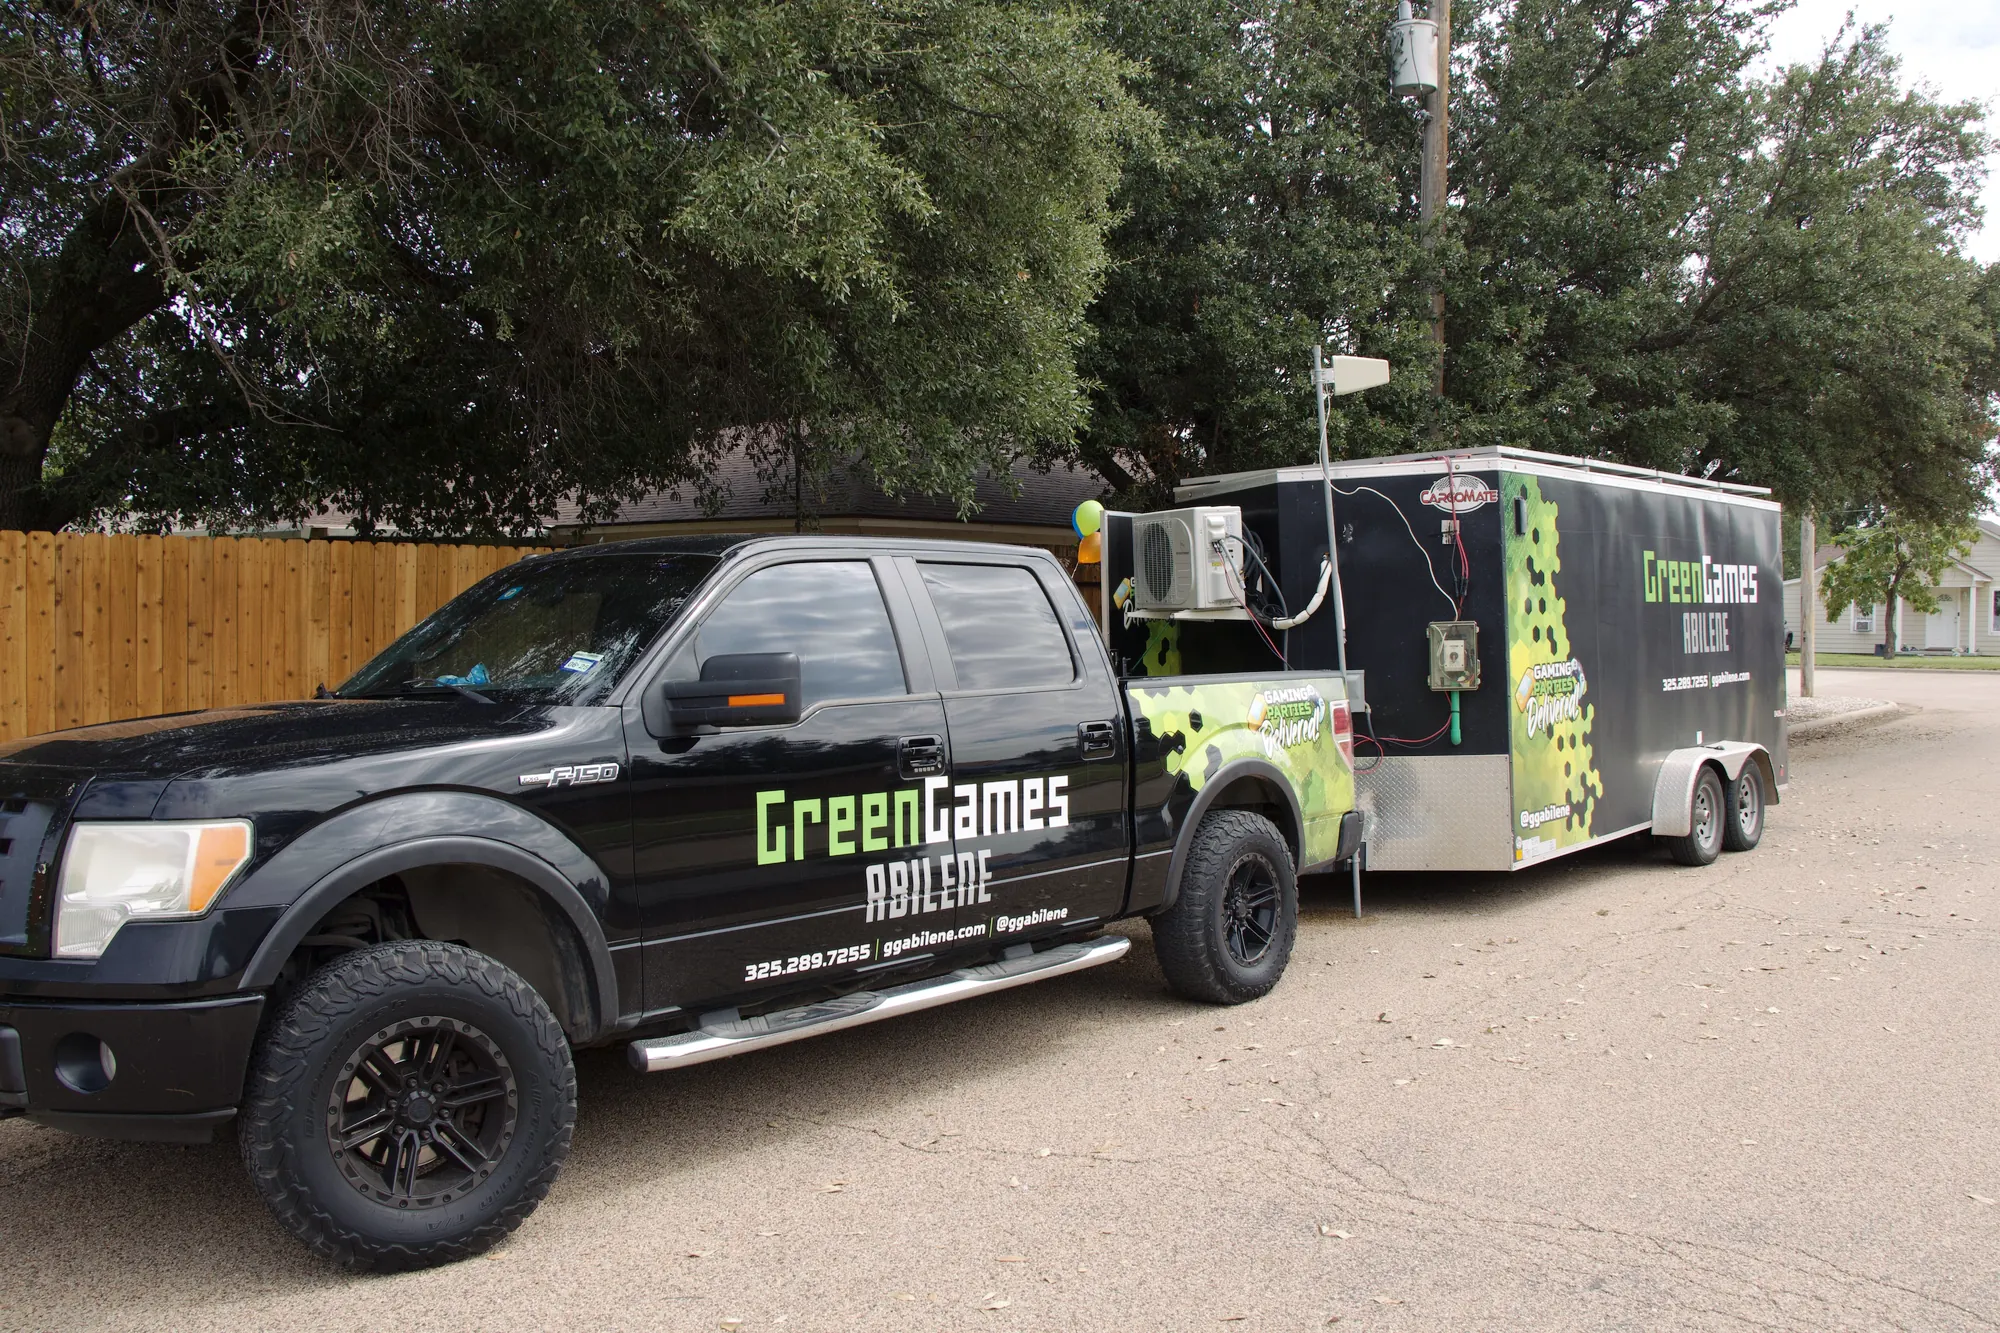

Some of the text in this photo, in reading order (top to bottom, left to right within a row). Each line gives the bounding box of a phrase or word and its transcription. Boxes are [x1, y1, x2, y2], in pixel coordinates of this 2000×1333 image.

[1682, 612, 1730, 654] ABILENE
[1534, 661, 1573, 680] GAMING
[1662, 670, 1750, 692] 325.289.7255 ggabilene.com
[1264, 687, 1308, 705] GAMING
[1533, 677, 1575, 697] PARTIES
[1266, 701, 1312, 720] PARTIES
[547, 763, 619, 788] F-150
[1520, 804, 1570, 829] @ggabilene
[865, 849, 992, 923] ABILENE
[744, 907, 1068, 982] 325.289.7255 ggabilene.com @ggabilene
